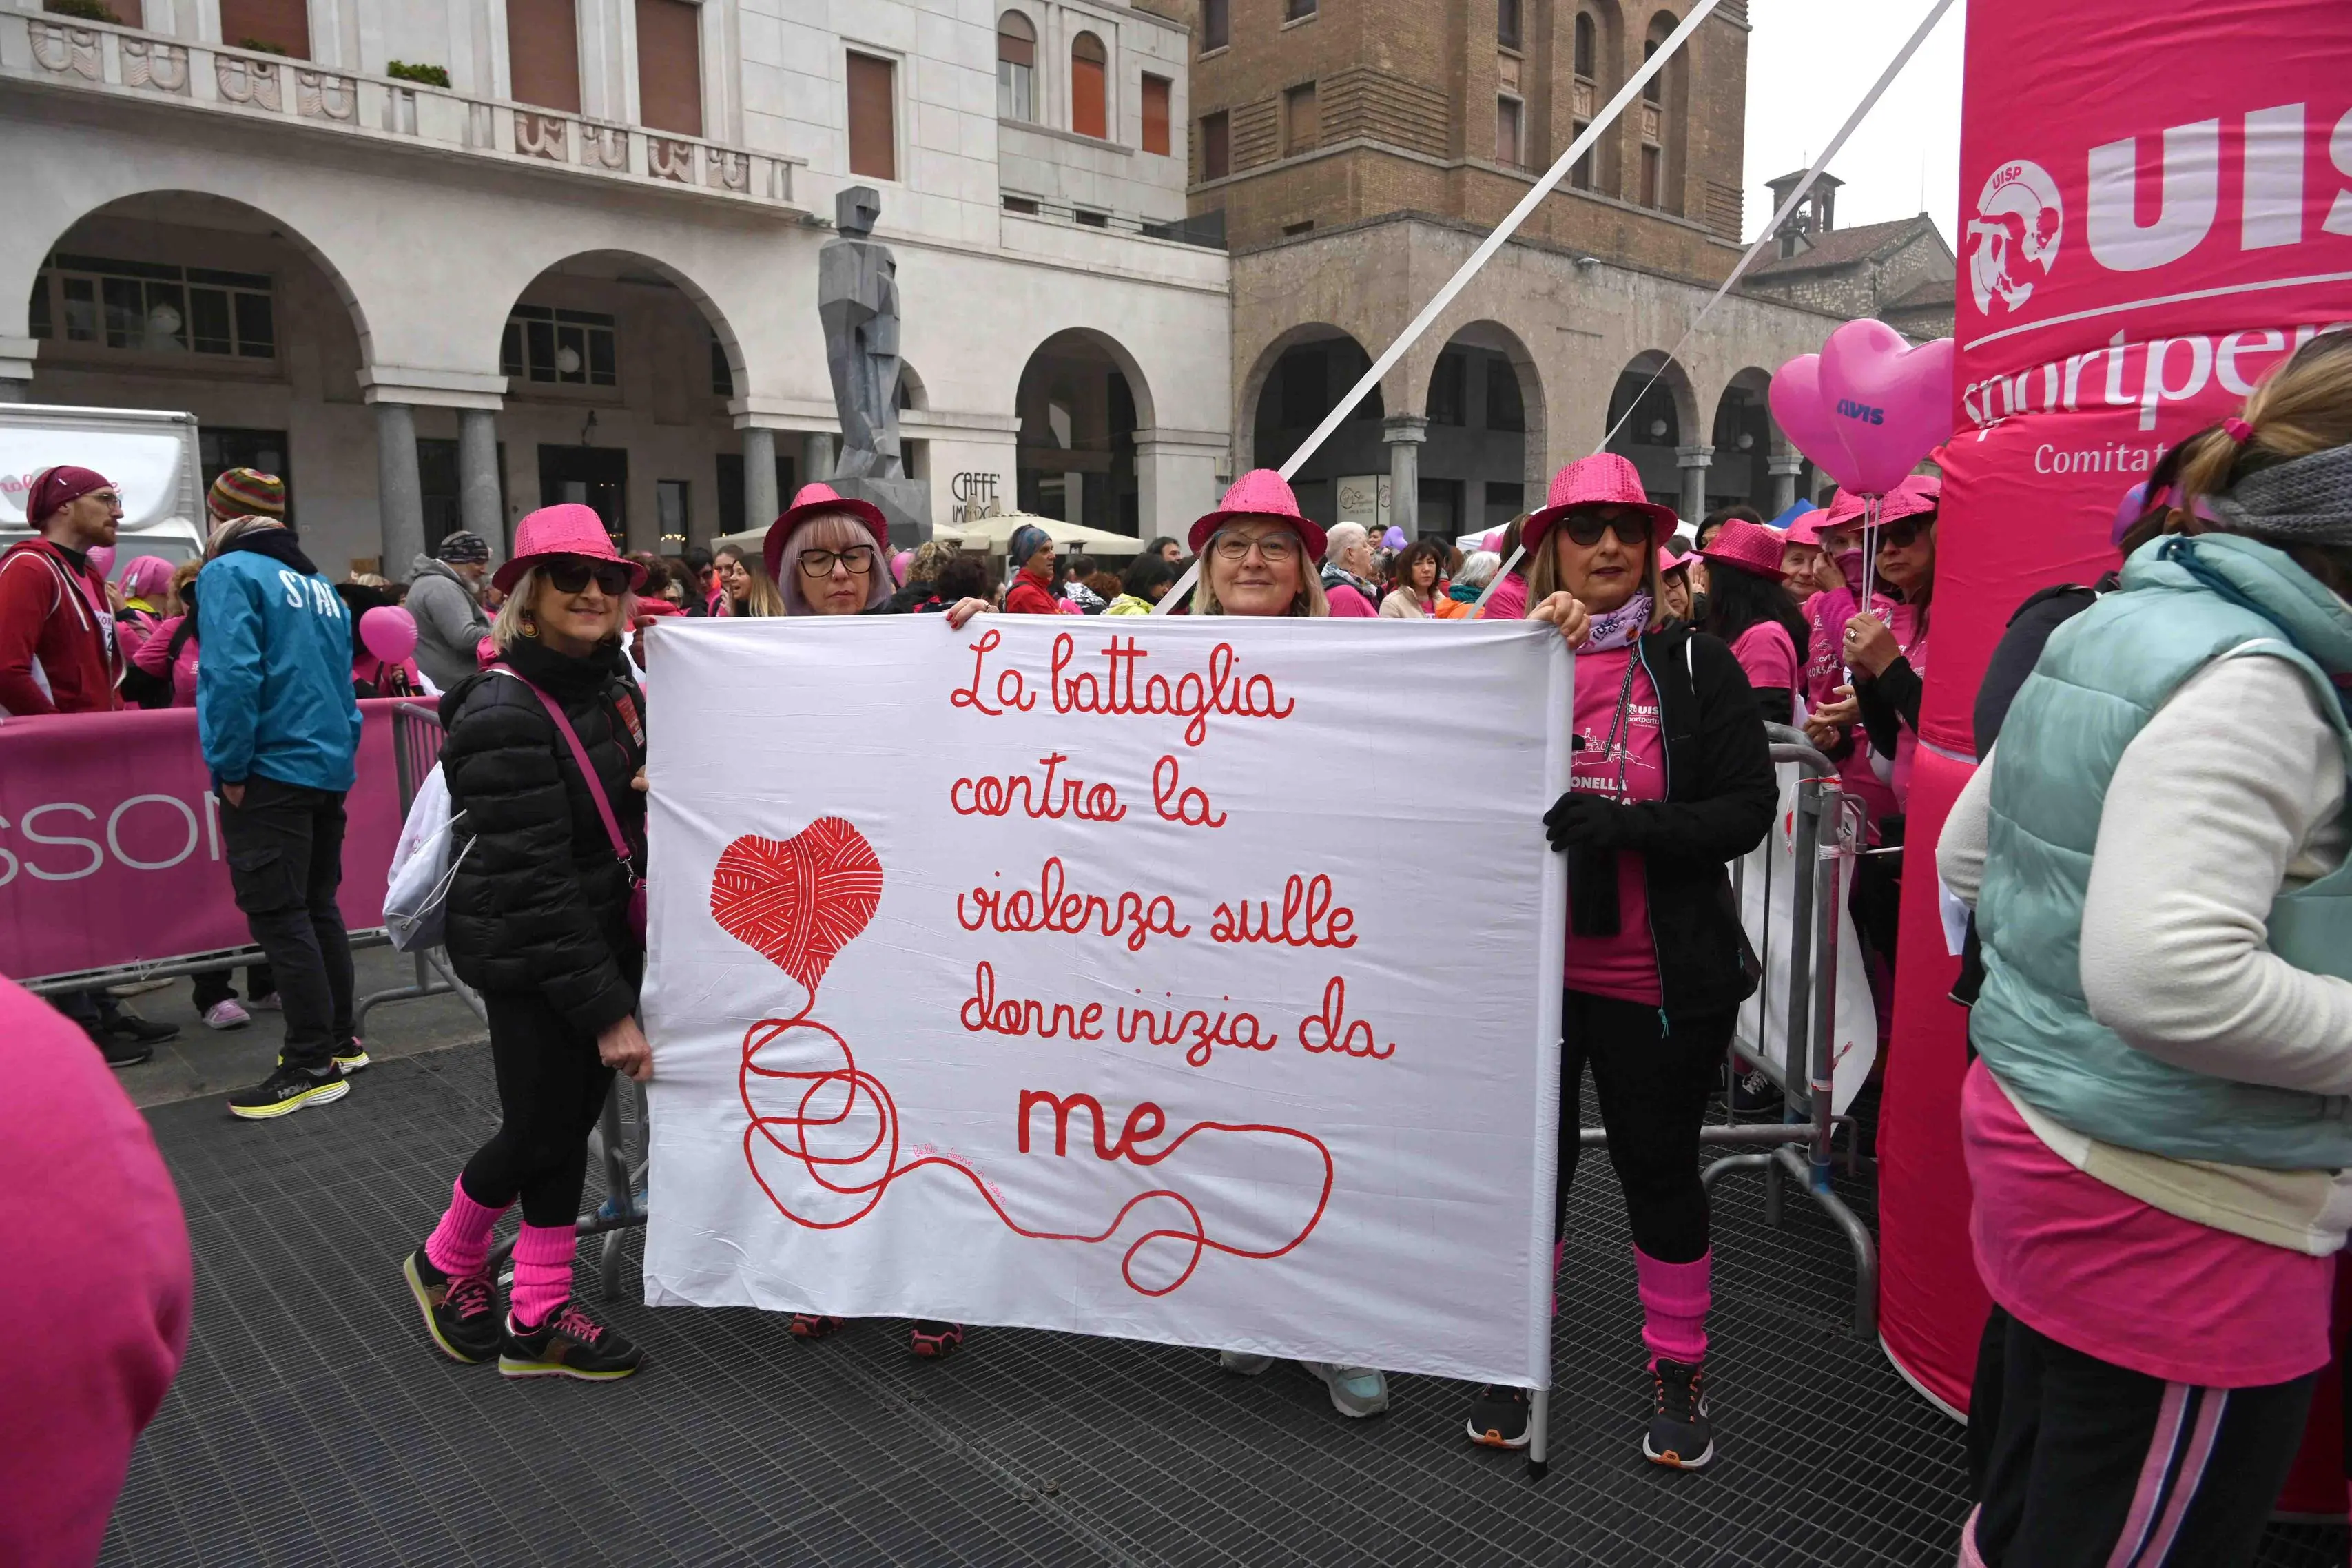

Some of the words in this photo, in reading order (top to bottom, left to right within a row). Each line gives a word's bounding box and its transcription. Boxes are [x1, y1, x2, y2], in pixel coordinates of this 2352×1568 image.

[1992, 166, 2022, 189] UISP
[1836, 399, 1884, 425] AVIS
[950, 628, 1037, 716] La
[1051, 632, 1295, 747] battaglia
[951, 752, 1126, 822] contro
[1153, 754, 1228, 828] la
[957, 856, 1191, 951] violenza
[1210, 874, 1359, 949] sulle
[960, 960, 1104, 1041] donne
[1117, 988, 1278, 1067] inizia
[1299, 976, 1396, 1060] da
[277, 1080, 312, 1099] HOKA
[1018, 1089, 1166, 1166] me
